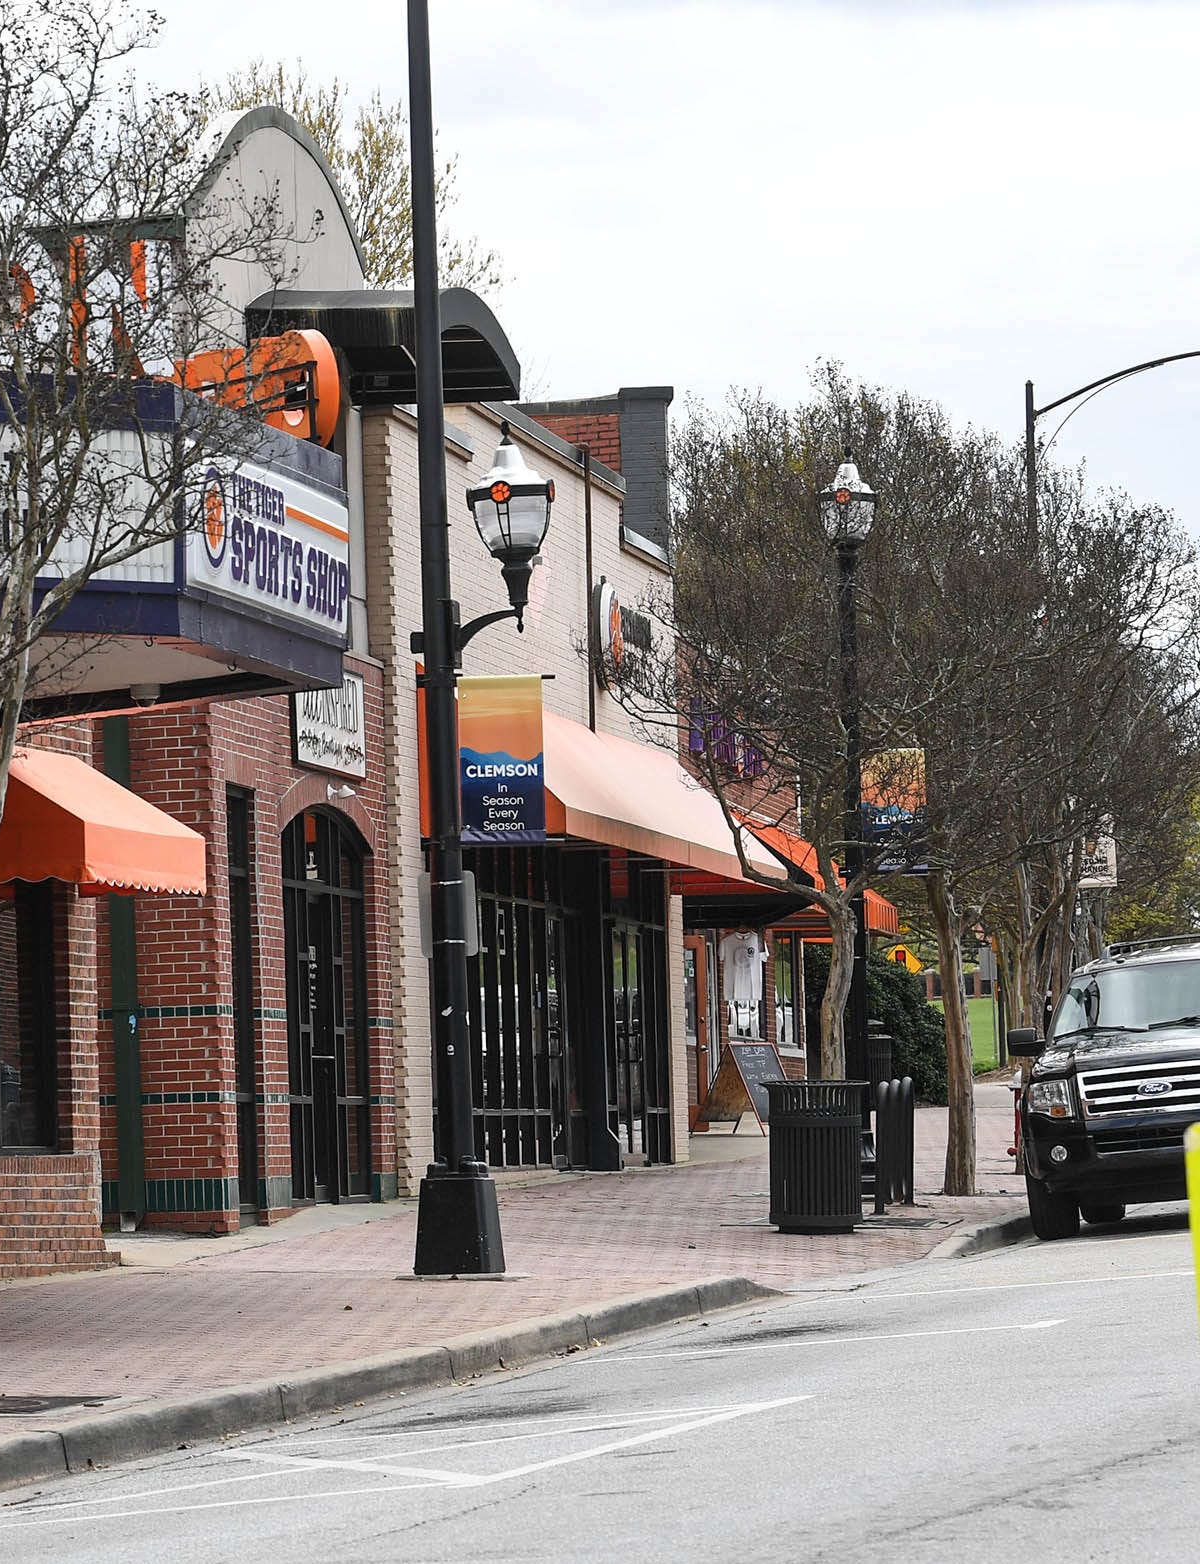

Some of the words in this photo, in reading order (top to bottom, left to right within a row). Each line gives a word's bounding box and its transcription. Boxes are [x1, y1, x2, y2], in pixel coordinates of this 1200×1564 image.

[254, 481, 286, 527] TIGER
[230, 515, 304, 605] SPORTS
[305, 546, 349, 622] SHOP
[466, 763, 538, 778] CLEMSON
[498, 784, 508, 793] In
[482, 795, 524, 806] Season
[488, 808, 519, 821] Every
[483, 820, 525, 831] Season
[1144, 1083, 1165, 1093] Ford
